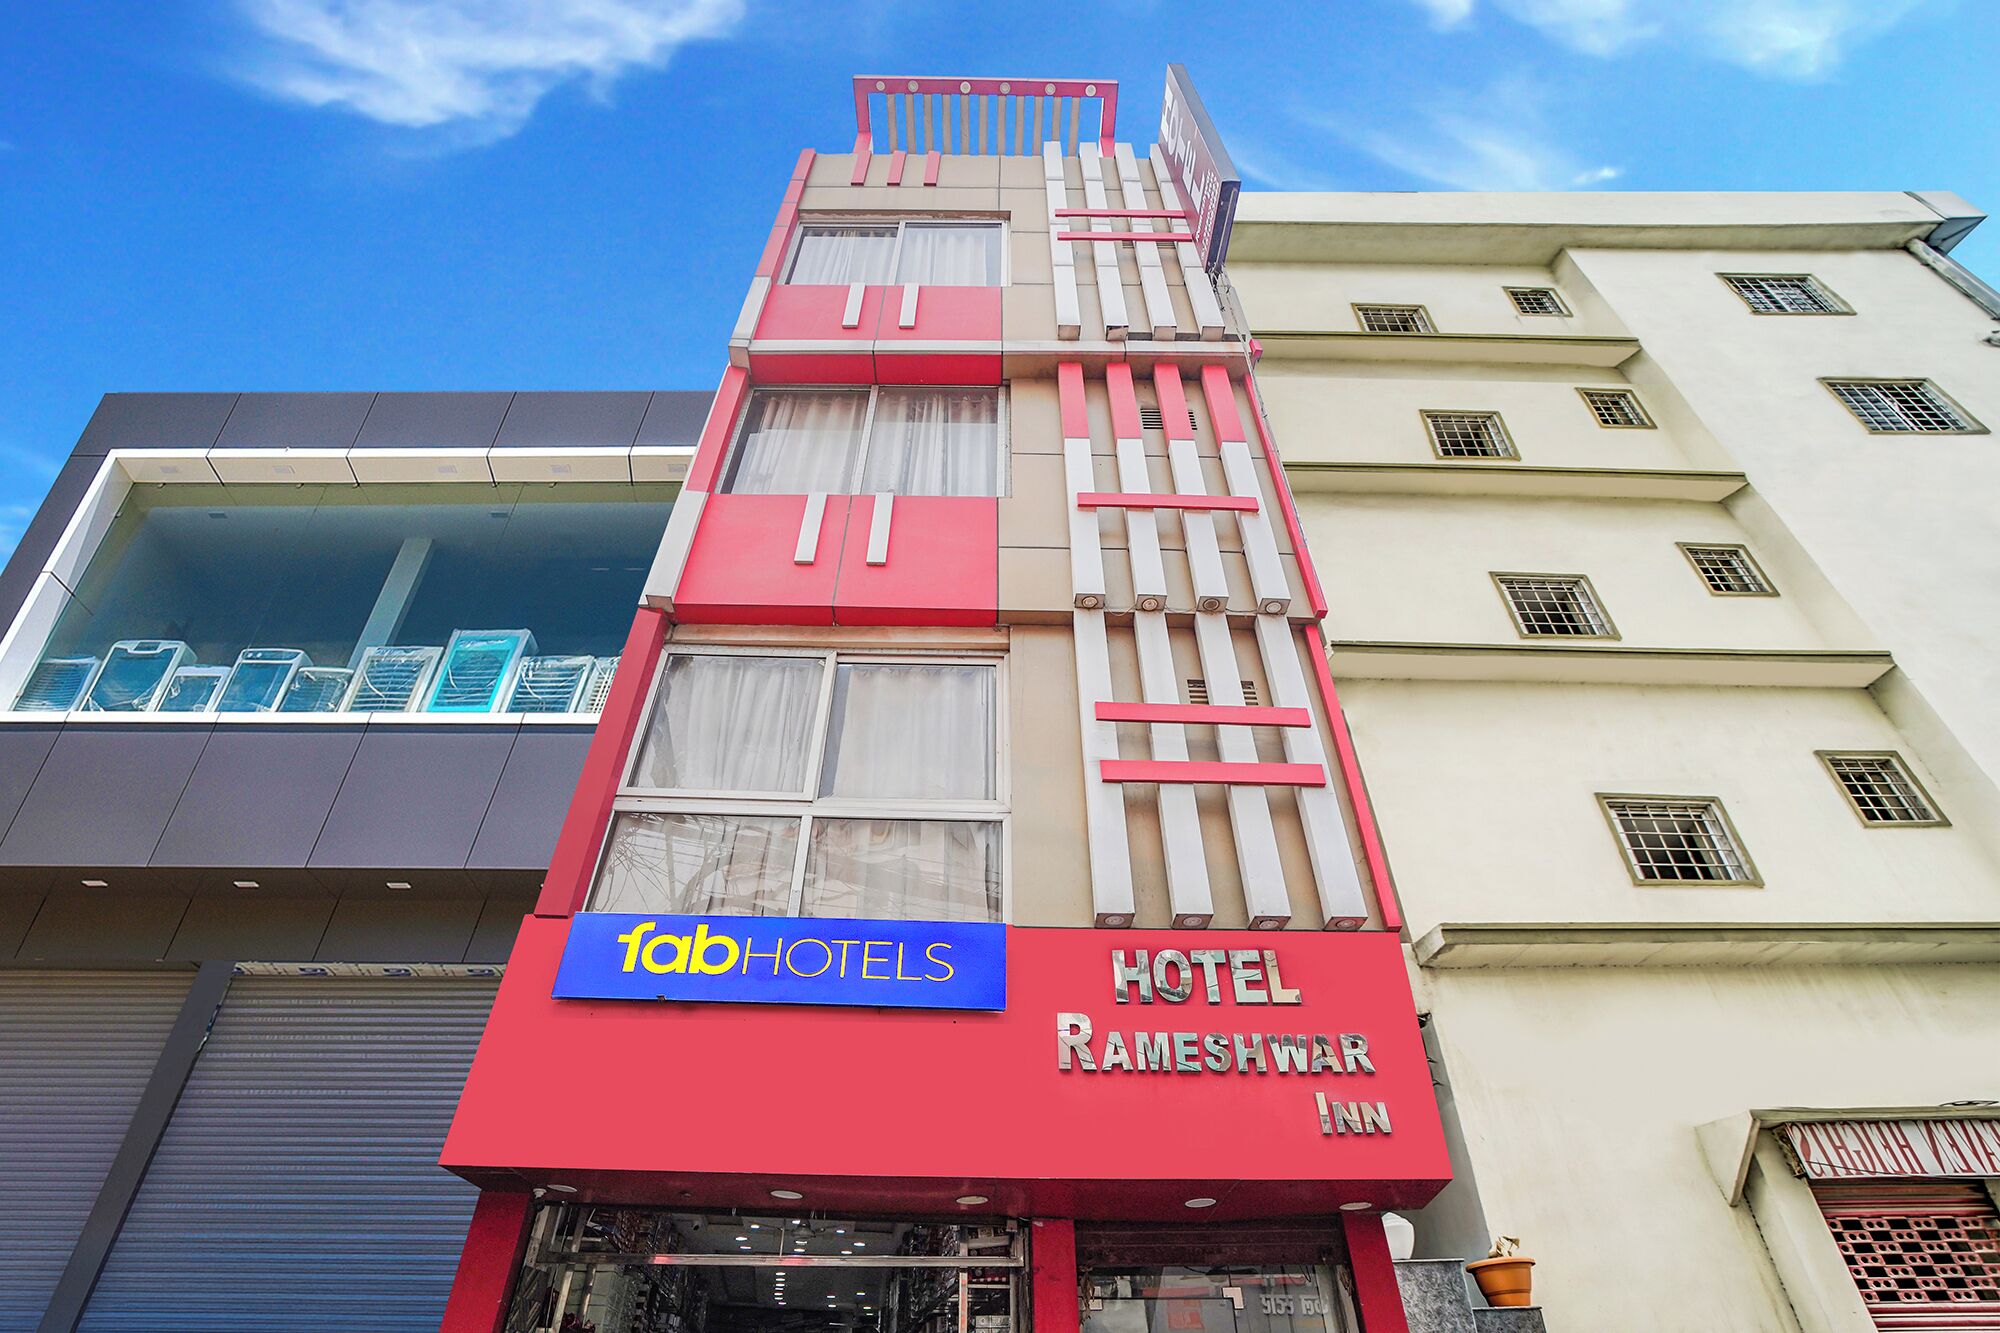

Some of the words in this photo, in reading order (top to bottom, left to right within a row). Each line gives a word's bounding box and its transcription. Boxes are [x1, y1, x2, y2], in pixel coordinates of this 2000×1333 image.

[1161, 82, 1206, 215] HOTEL
[1111, 949, 1302, 1005] HOTEL
[1057, 1012, 1376, 1074] RAMESHWAR
[1315, 1091, 1392, 1135] INN
